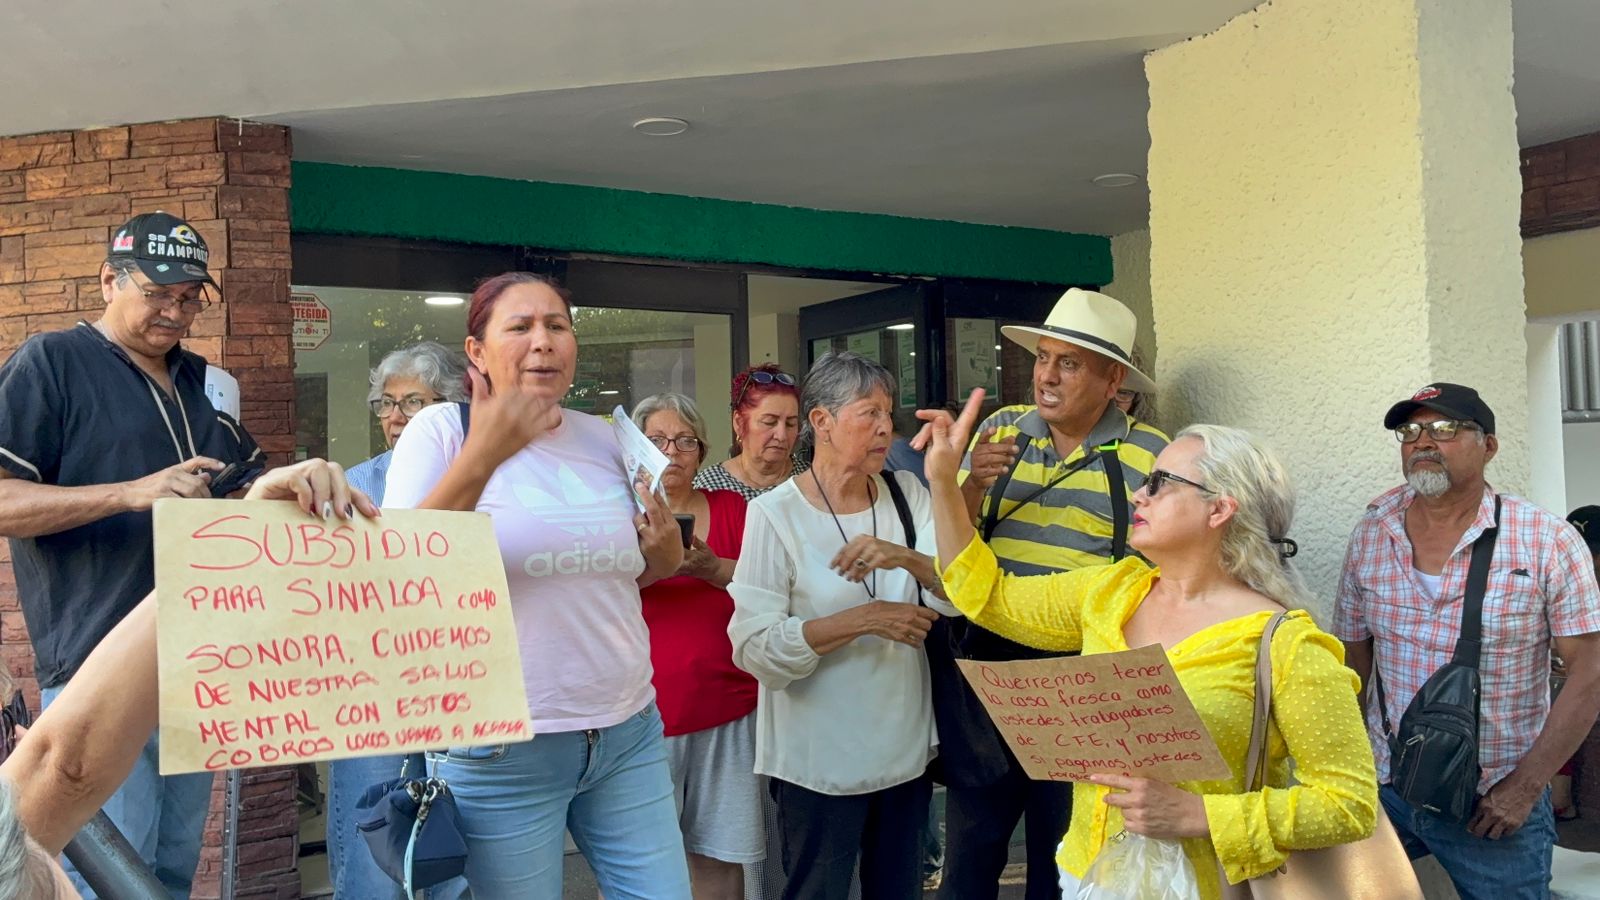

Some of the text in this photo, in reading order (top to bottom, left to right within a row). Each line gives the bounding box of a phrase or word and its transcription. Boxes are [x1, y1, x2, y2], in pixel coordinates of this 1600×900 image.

[147, 241, 208, 262] CHAMPION
[190, 514, 449, 570] SUBSIDIO
[184, 584, 266, 613] PARA
[287, 576, 443, 615] SINALOA
[372, 625, 491, 658] CUIDEMOS
[194, 660, 487, 709] DE NUESTRA SALUD
[980, 663, 1164, 690] Querremos tener
[981, 684, 1172, 708] la casa fresca como
[199, 692, 471, 746] MENTAL CON ESTOS
[1000, 704, 1174, 733] ustedes trabajadores
[205, 736, 334, 769] COBROS
[1016, 733, 1039, 746] de
[1116, 738, 1132, 756] y
[1136, 726, 1201, 745] nosotros
[1133, 751, 1202, 768] ustedes
